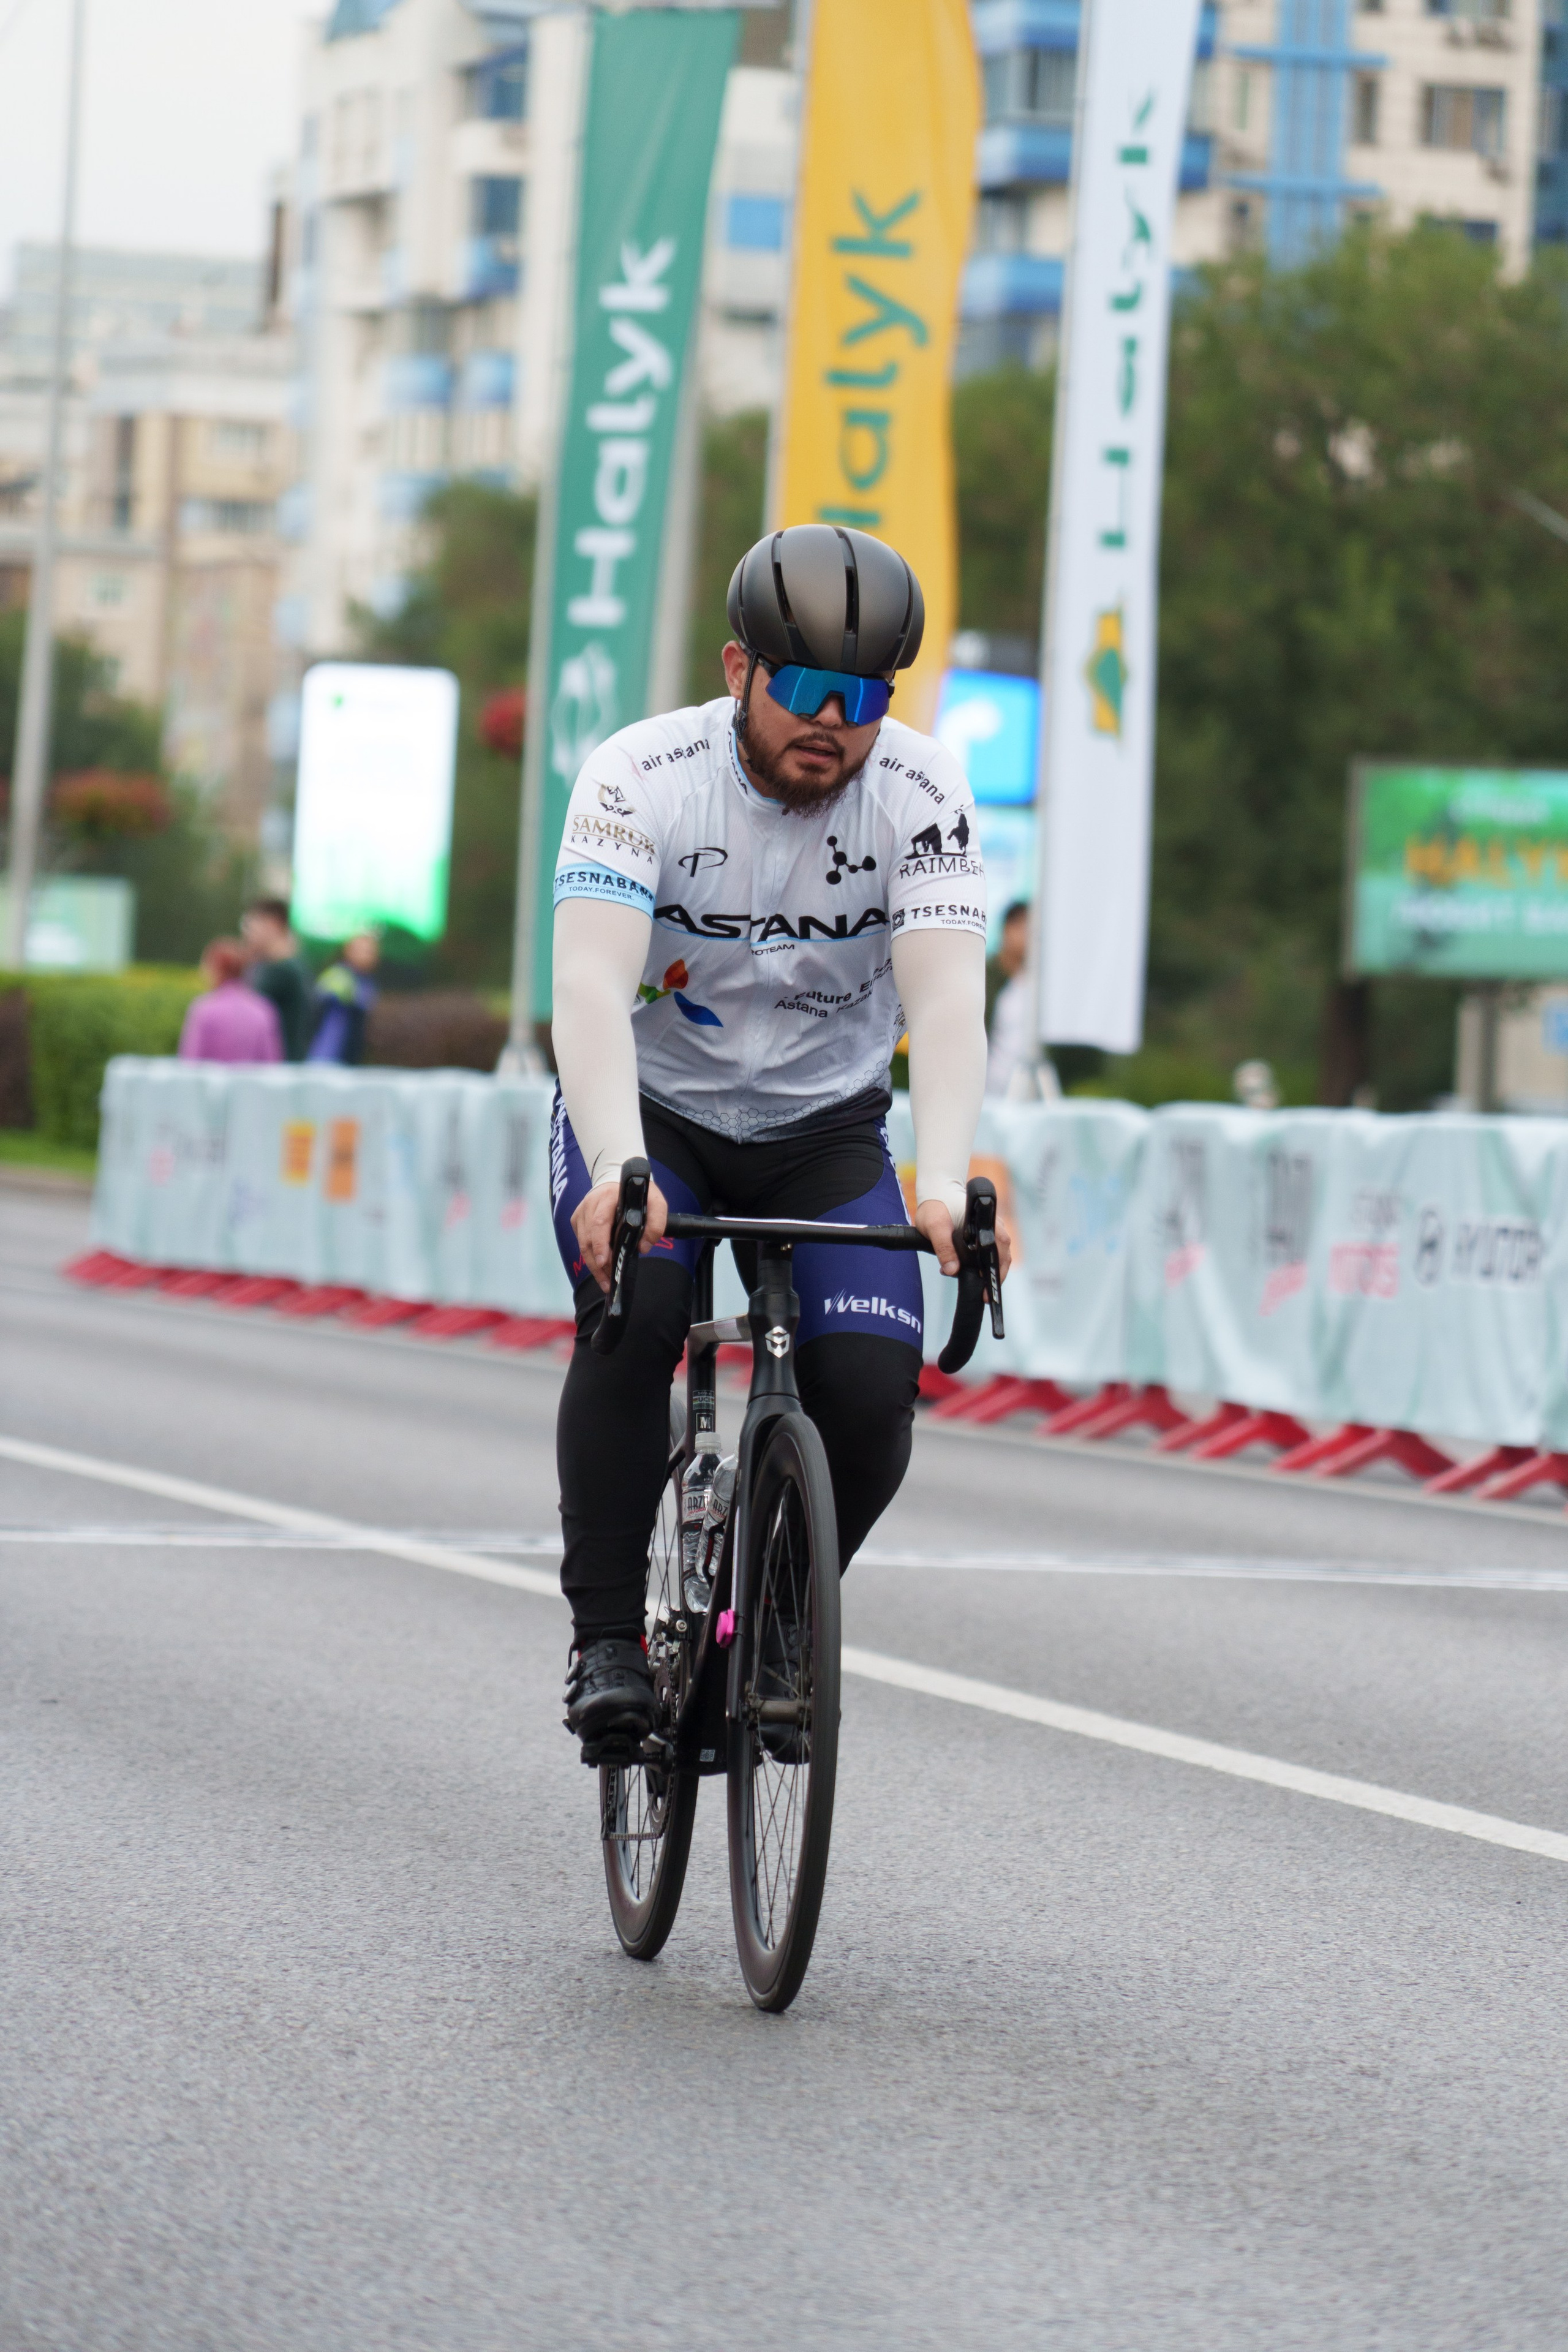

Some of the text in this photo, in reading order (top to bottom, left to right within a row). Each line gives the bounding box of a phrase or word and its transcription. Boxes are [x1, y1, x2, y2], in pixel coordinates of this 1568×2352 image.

[567, 236, 677, 628] Halyk
[641, 739, 710, 771] air asana
[879, 758, 945, 805] air asana
[571, 835, 653, 864] KAZYNA
[573, 816, 655, 854] SAMRUK
[911, 905, 986, 924] TSESNAB
[751, 944, 795, 956] OTEAM
[774, 1000, 828, 1018] Astana
[794, 990, 852, 1005] Future
[824, 1289, 921, 1334] Welksn
[699, 1416, 711, 1429] M
